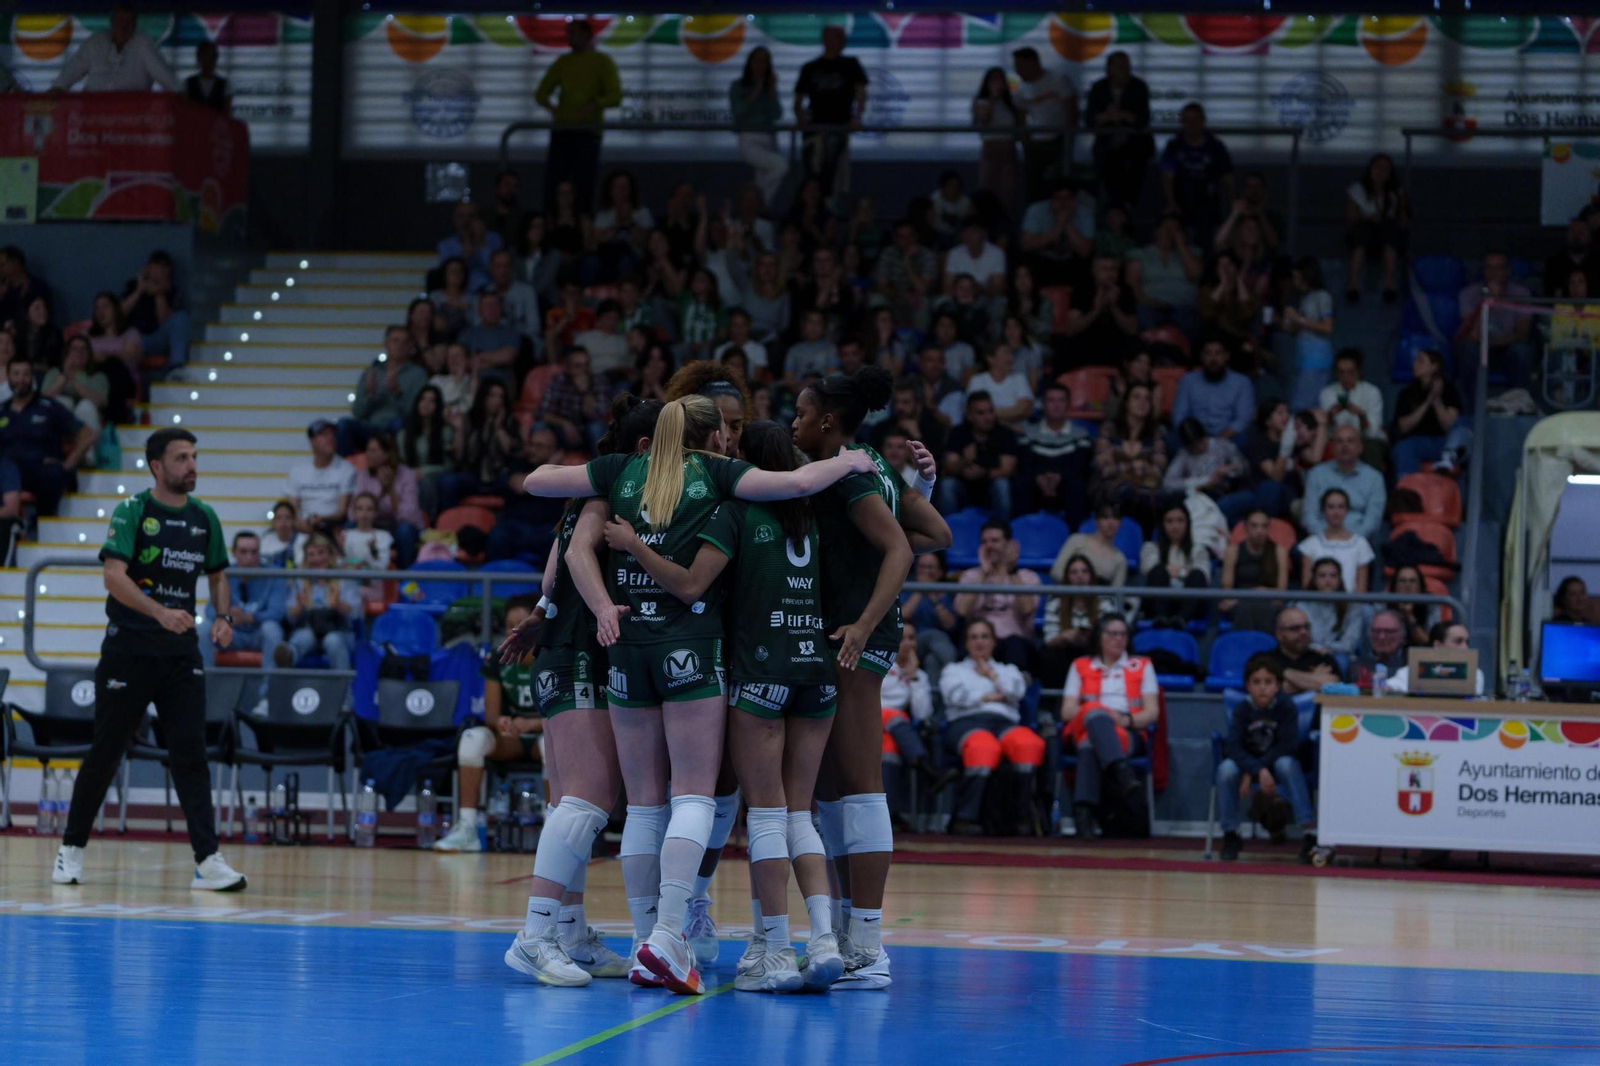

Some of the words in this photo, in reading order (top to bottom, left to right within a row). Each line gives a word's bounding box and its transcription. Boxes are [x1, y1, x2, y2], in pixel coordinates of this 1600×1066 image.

[786, 576, 814, 590] WAY
[580, 687, 589, 699] 4
[1458, 760, 1581, 782] Ayuntamiento
[1586, 764, 1600, 781] d
[1458, 783, 1498, 803] Dos
[1457, 806, 1507, 819] Deportes
